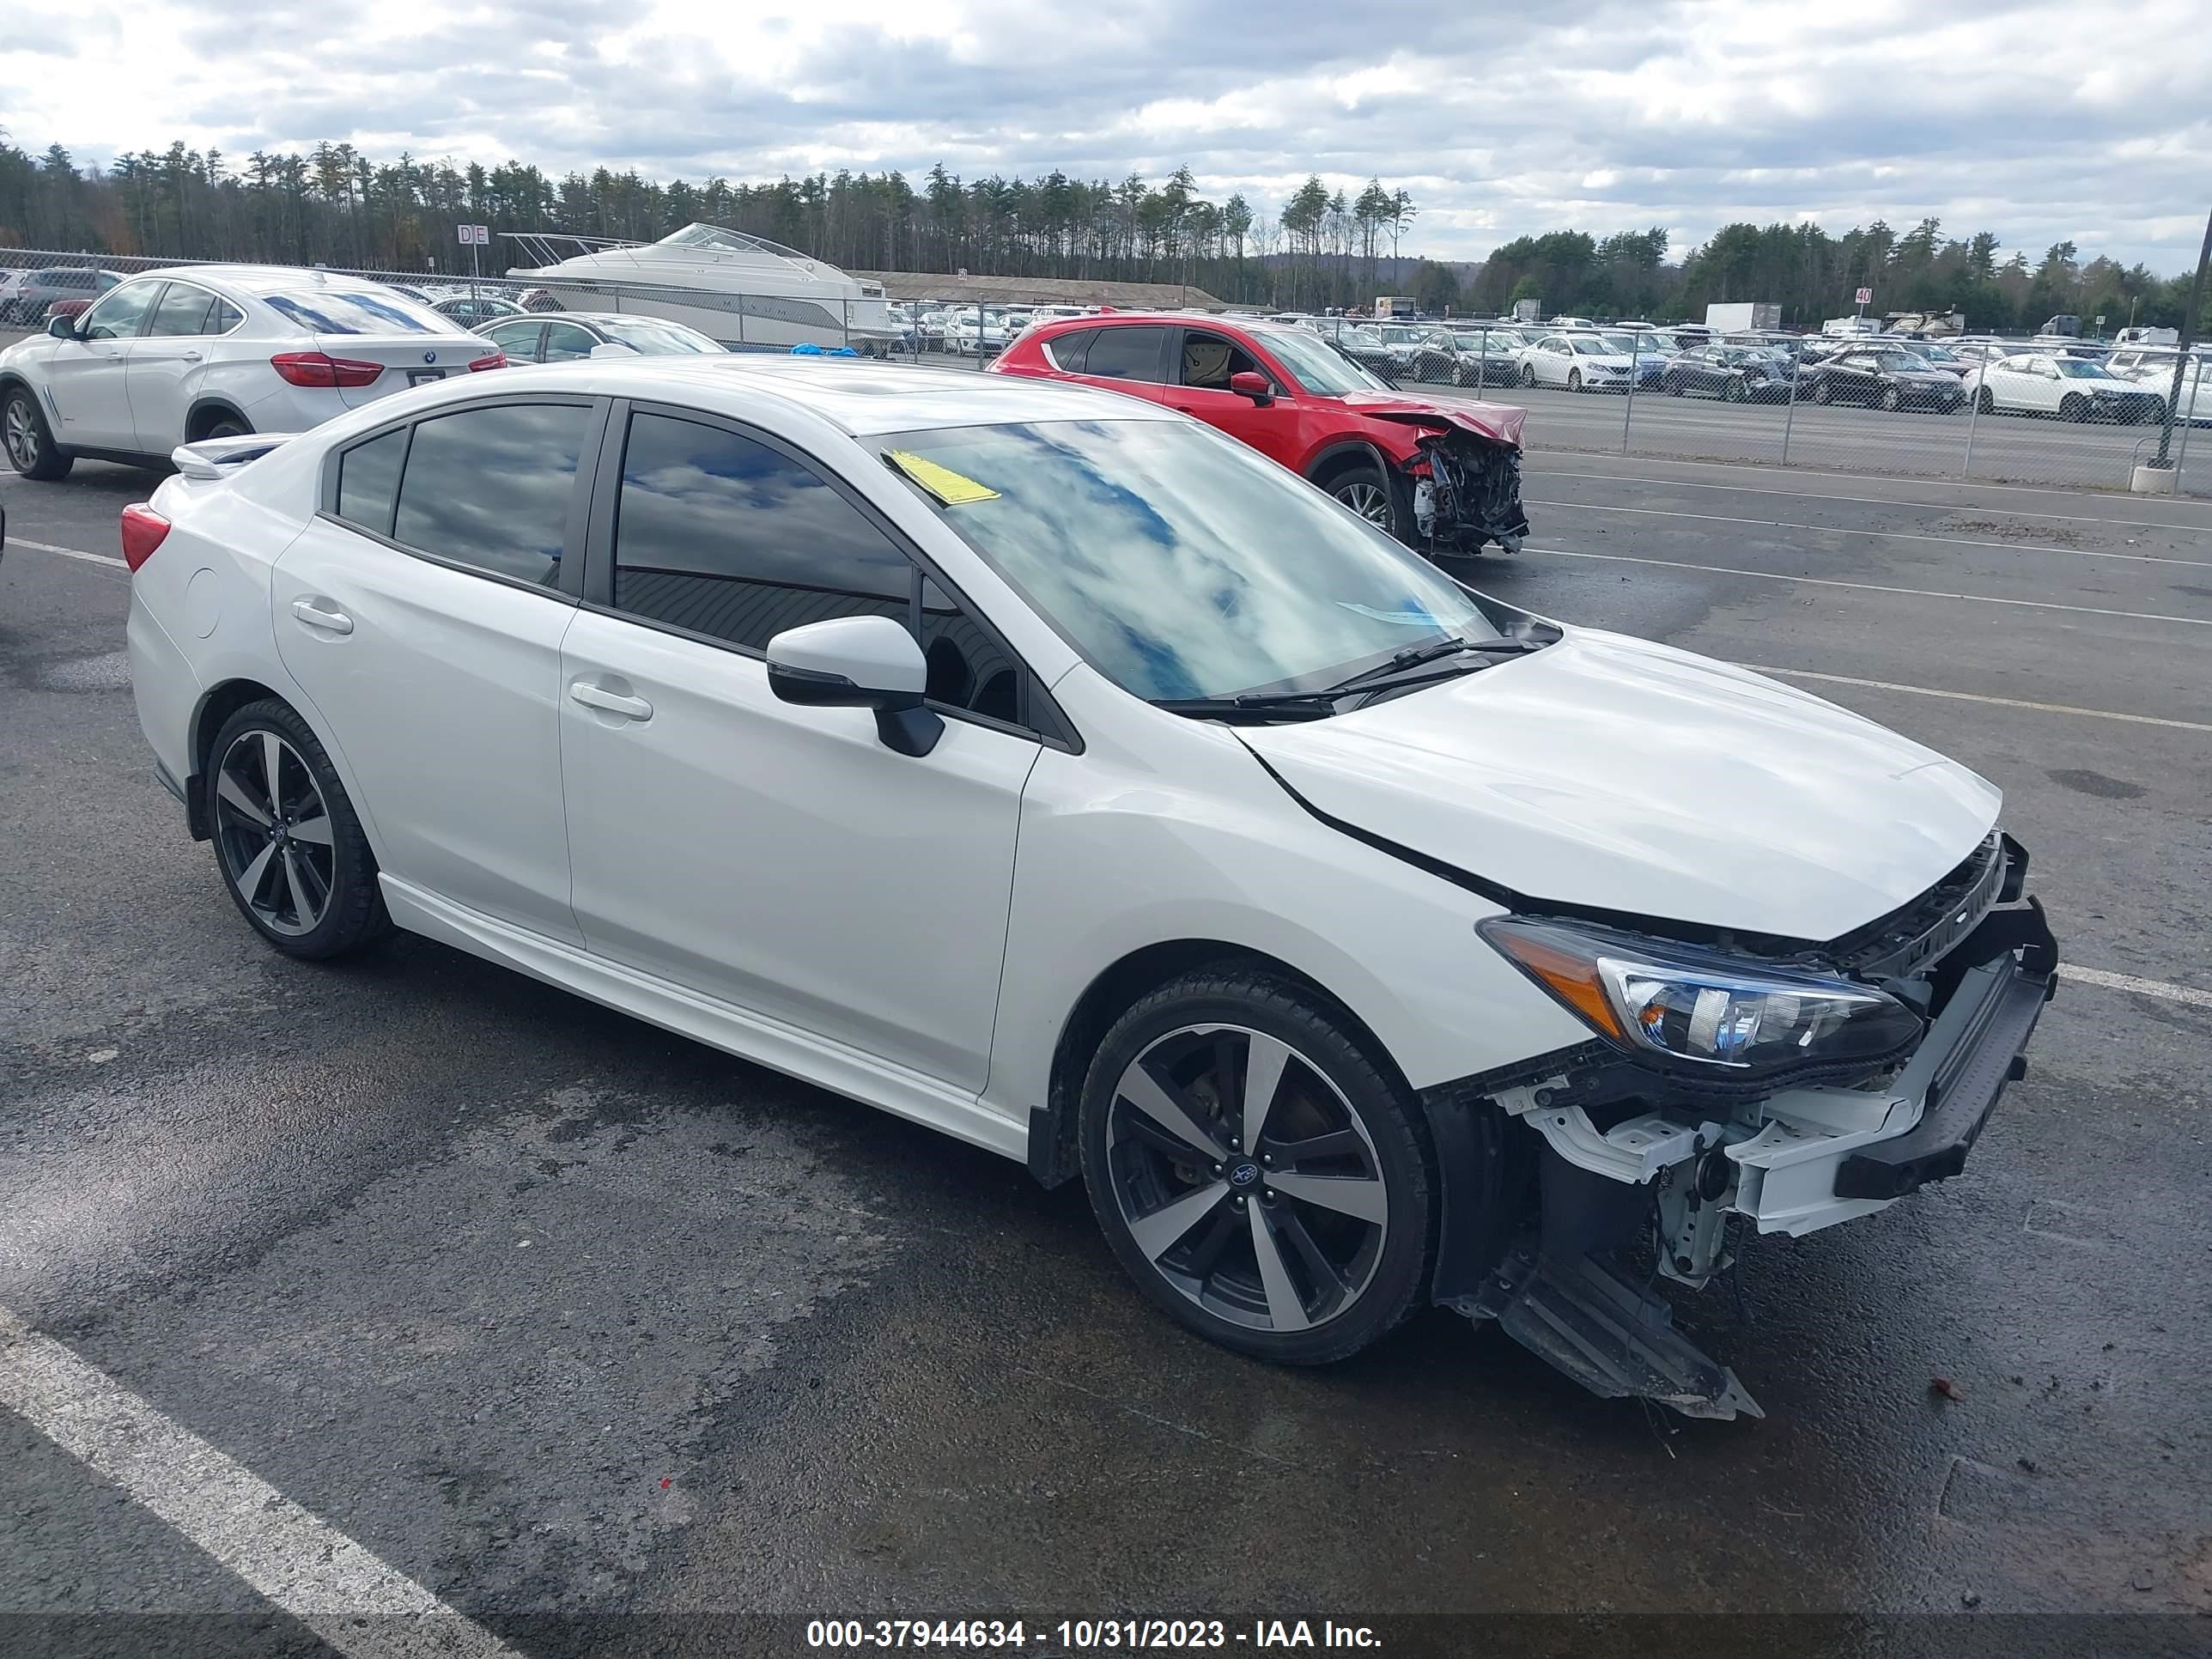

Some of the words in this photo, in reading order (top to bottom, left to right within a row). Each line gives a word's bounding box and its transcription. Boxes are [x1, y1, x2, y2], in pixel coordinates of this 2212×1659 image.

[461, 227, 471, 241] D
[477, 227, 486, 242] E
[1856, 289, 1871, 302] 40
